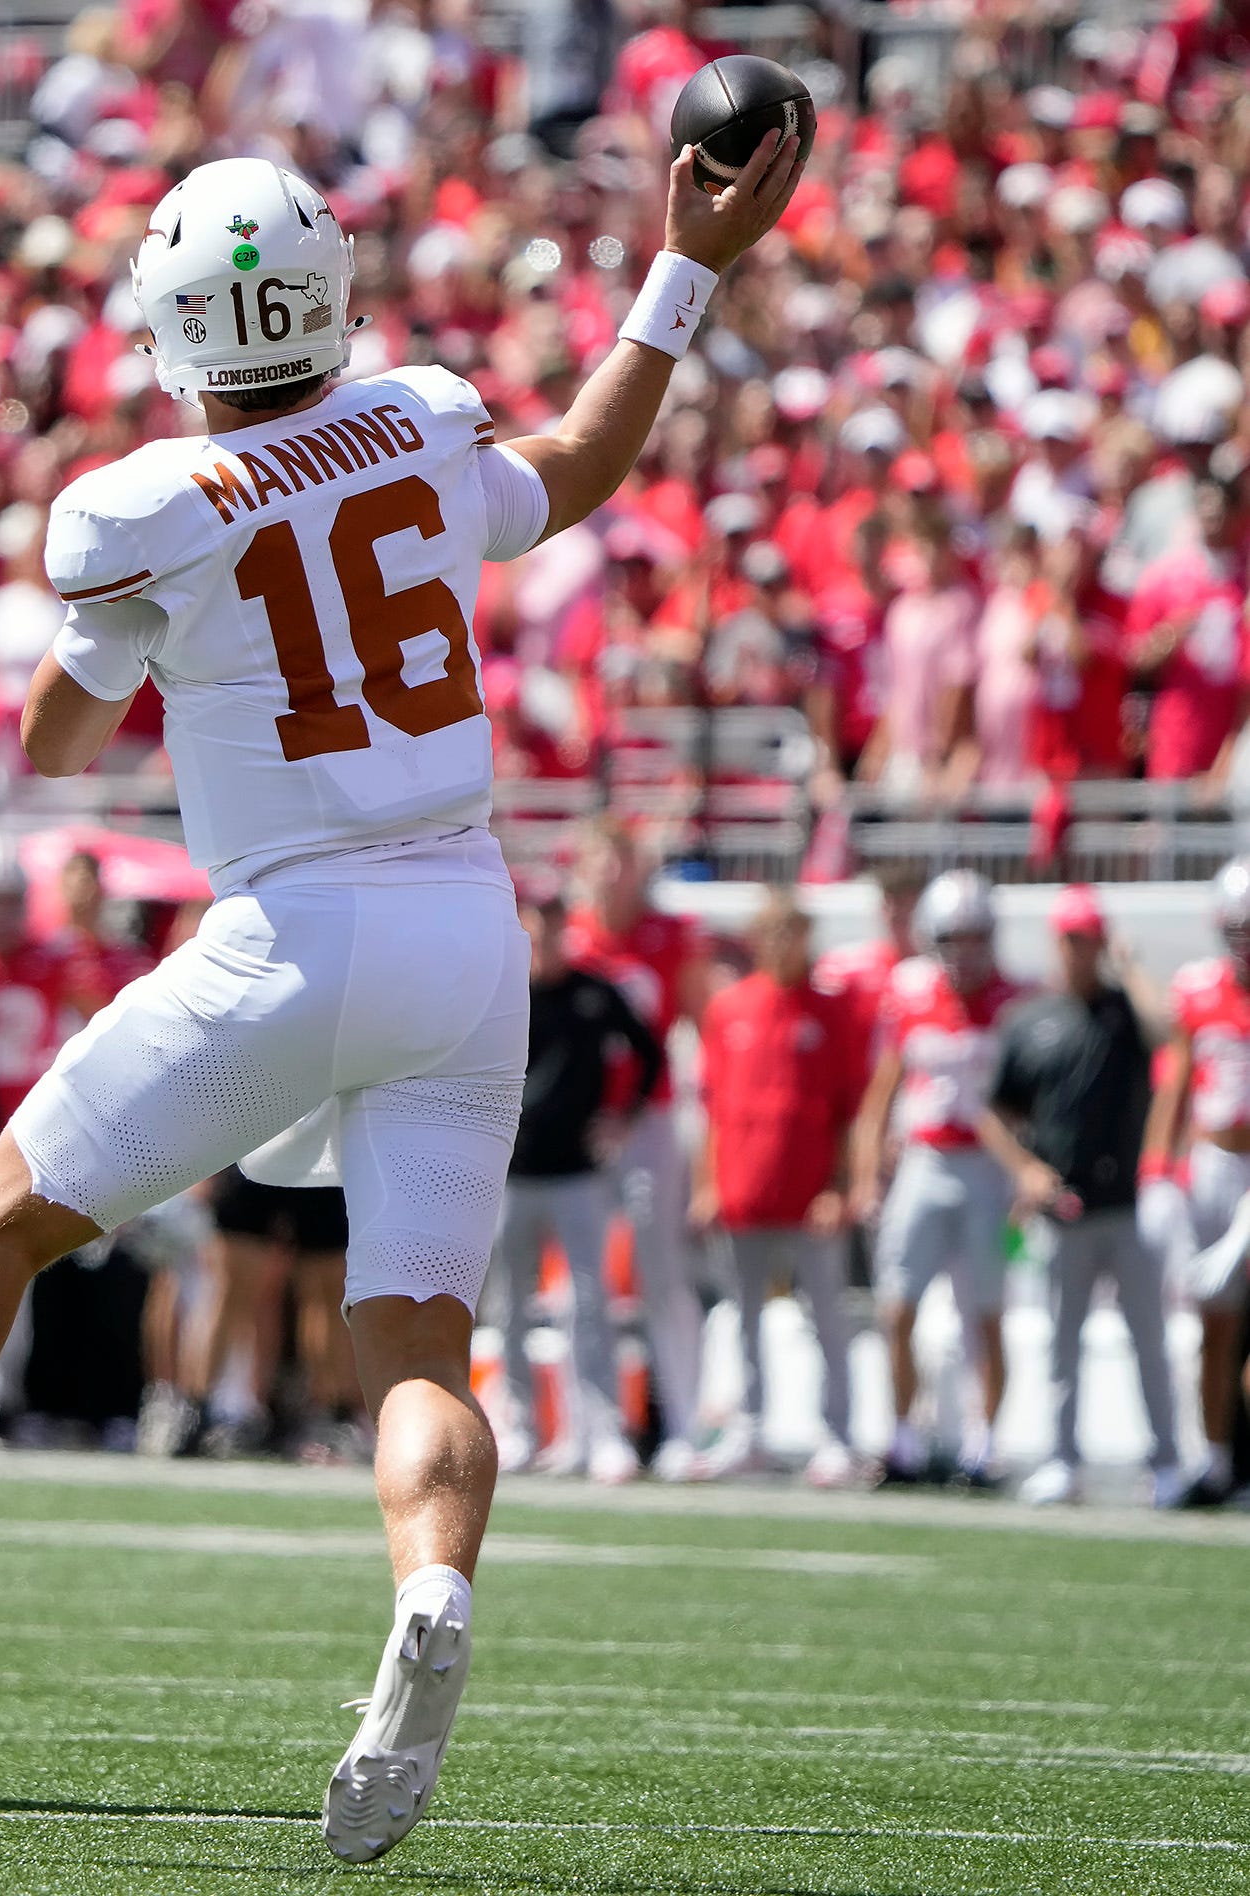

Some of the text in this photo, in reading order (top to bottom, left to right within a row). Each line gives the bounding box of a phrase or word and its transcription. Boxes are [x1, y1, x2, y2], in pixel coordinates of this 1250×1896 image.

[235, 250, 258, 262] C2P
[183, 318, 207, 343] SEC
[230, 277, 291, 345] 16
[206, 357, 313, 386] LONGHORNS
[190, 404, 425, 525] MANNING
[234, 474, 484, 763] 16
